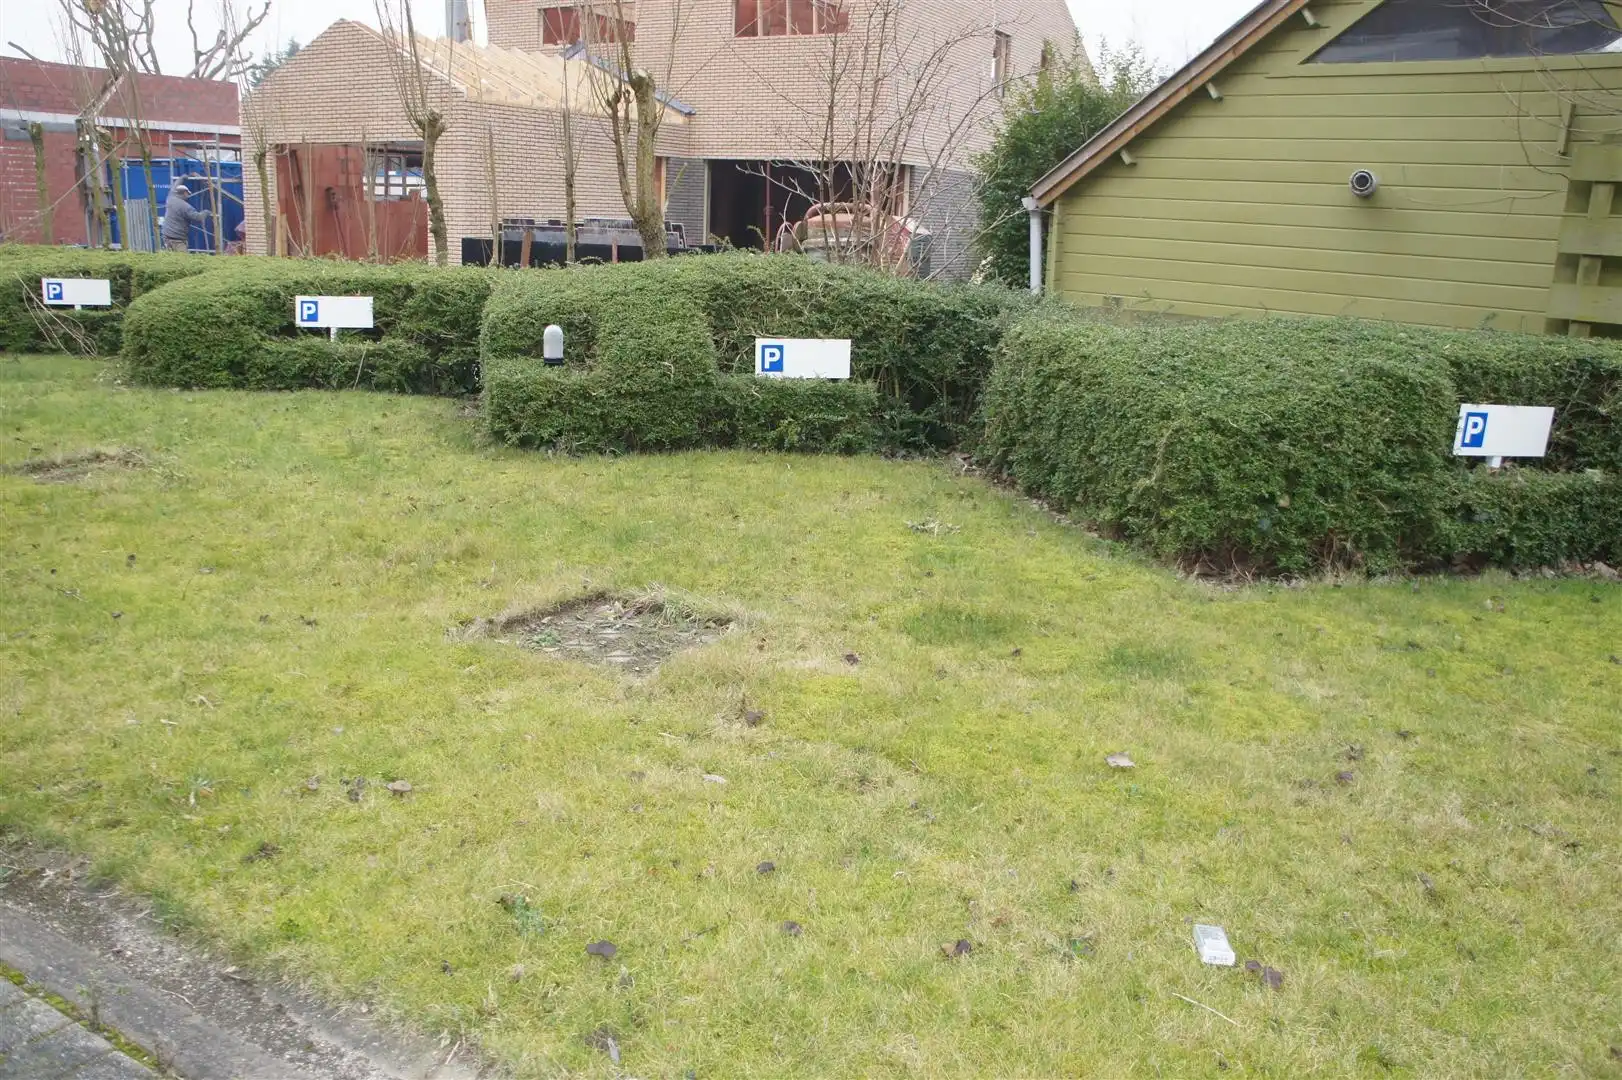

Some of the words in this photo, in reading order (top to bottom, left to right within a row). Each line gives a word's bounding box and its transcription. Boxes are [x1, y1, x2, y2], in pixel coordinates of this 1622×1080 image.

[49, 284, 60, 298] P
[302, 303, 316, 320] P
[764, 347, 781, 369] P
[1464, 416, 1484, 443] P
